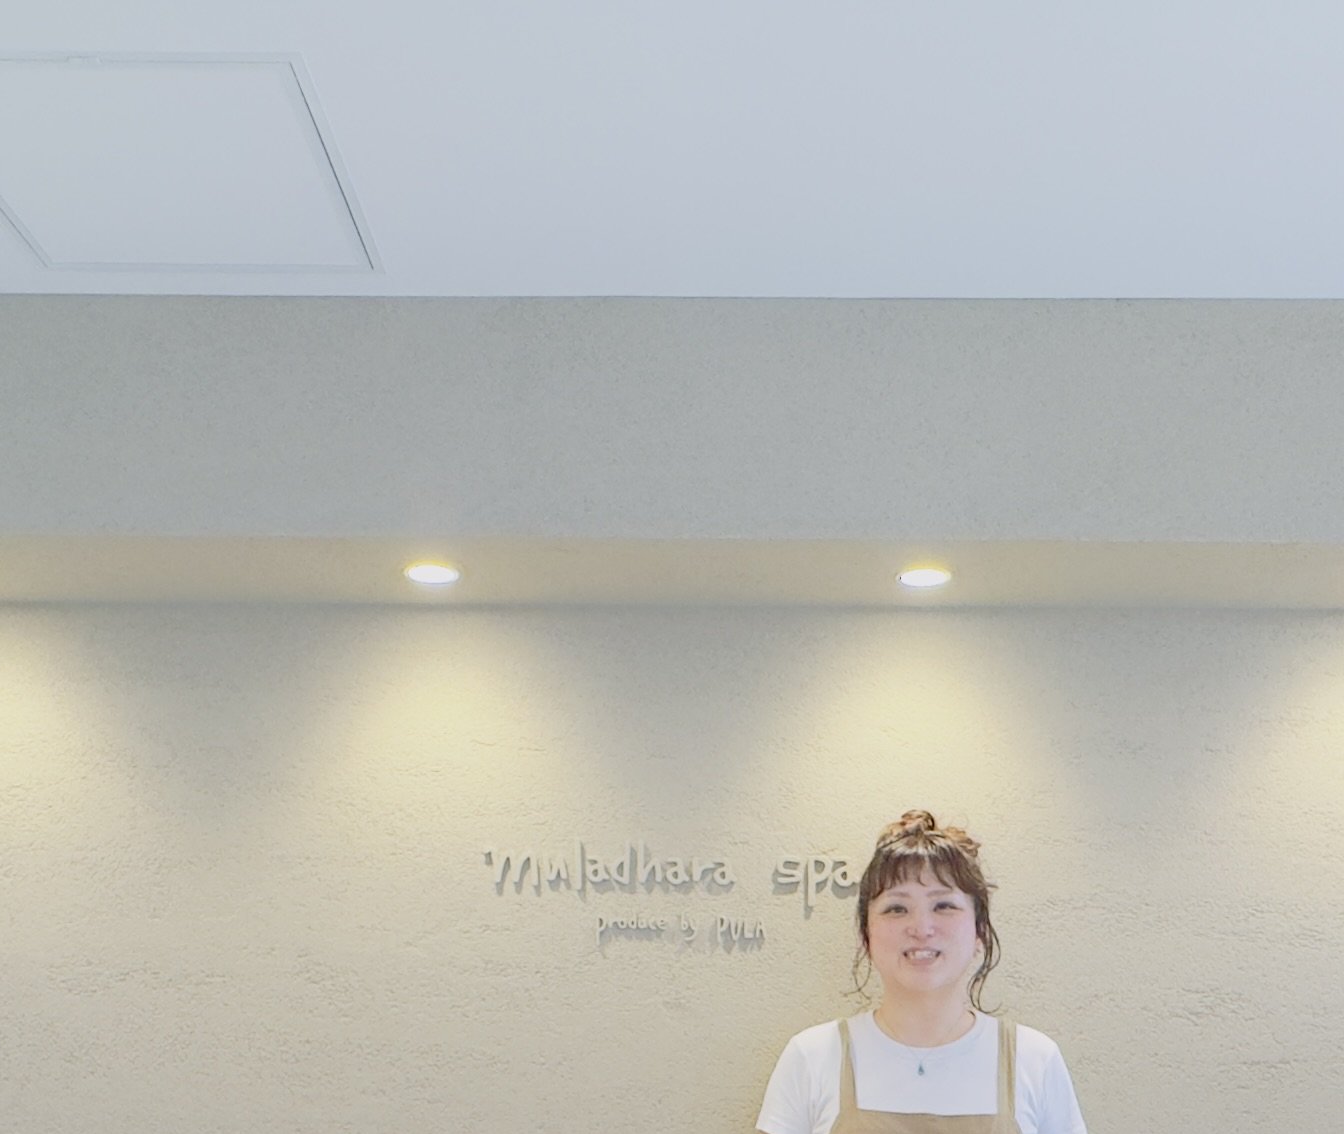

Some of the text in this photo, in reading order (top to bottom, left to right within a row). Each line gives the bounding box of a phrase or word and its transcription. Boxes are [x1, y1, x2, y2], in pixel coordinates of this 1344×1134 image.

[773, 855, 860, 914] spa
[596, 913, 767, 945] produce by PULA
